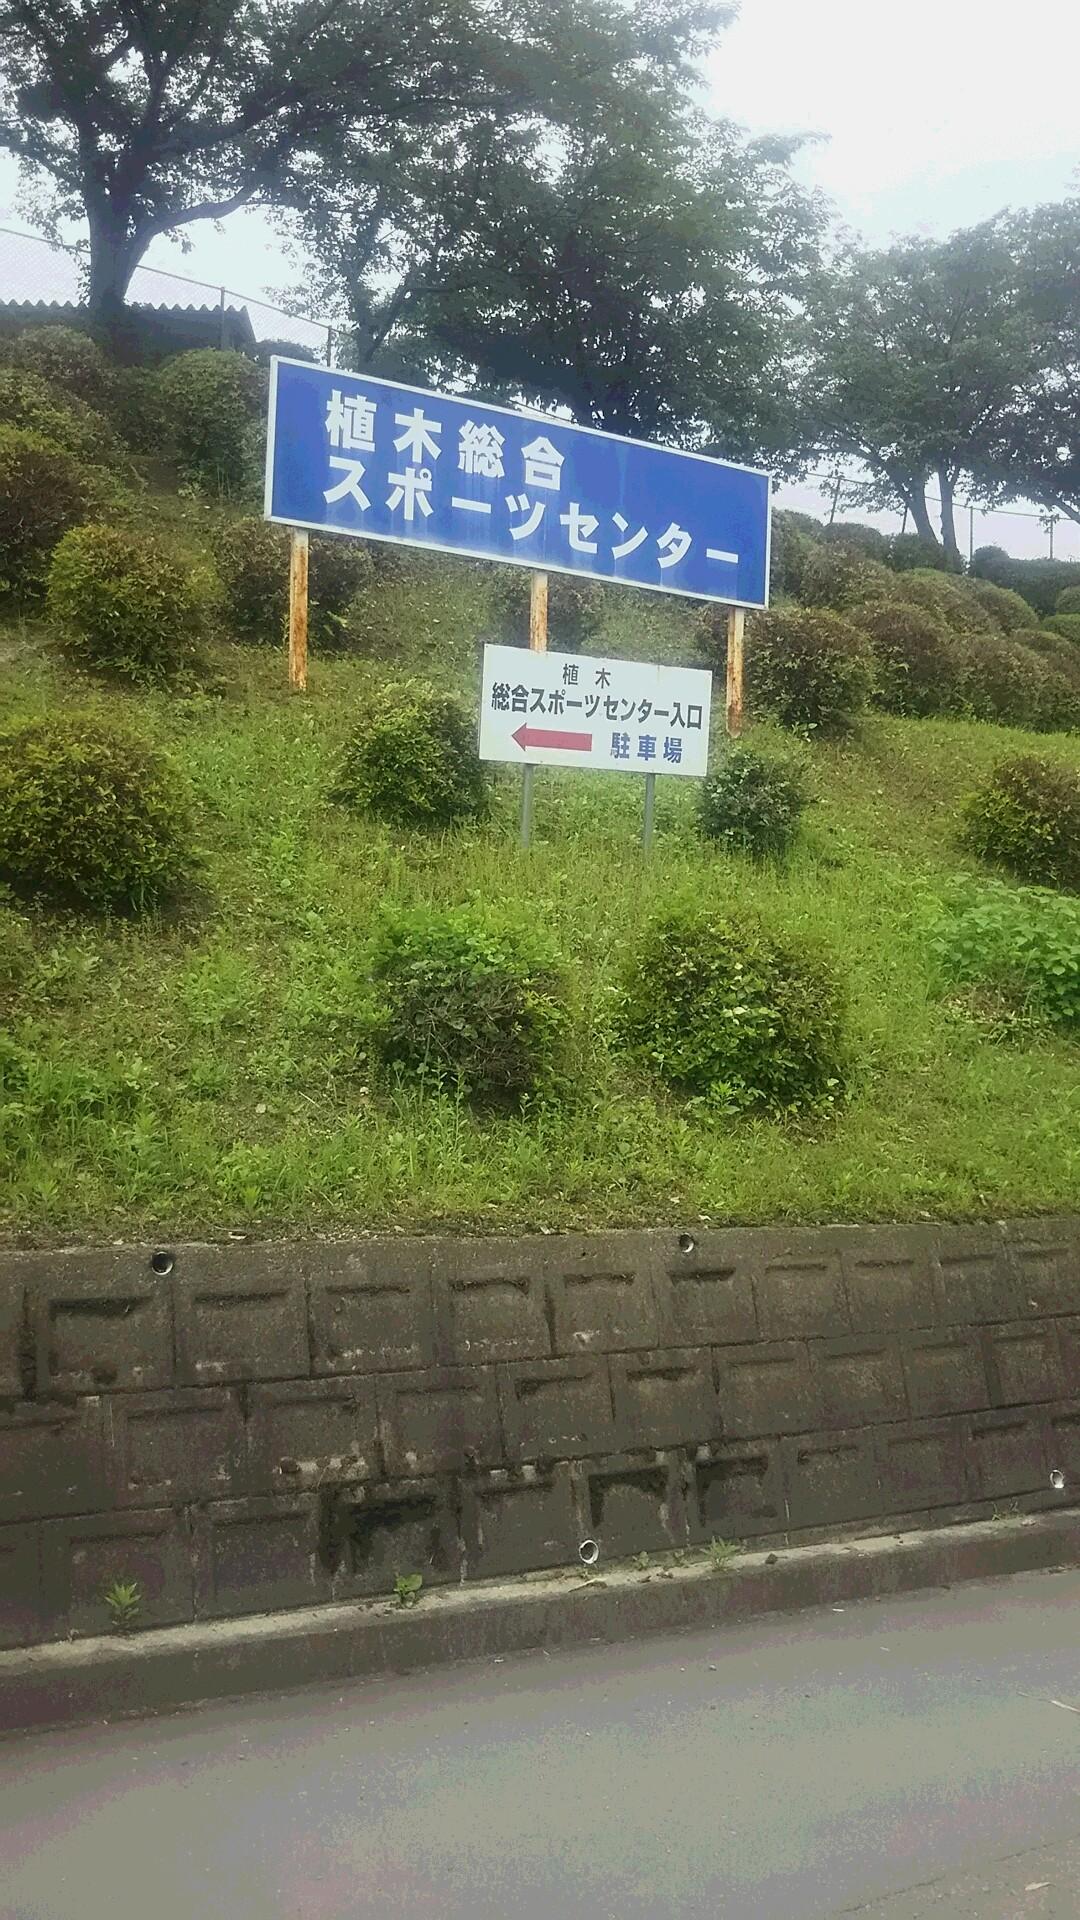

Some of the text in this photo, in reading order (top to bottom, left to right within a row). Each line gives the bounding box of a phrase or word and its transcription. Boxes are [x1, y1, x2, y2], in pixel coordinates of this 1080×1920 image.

[325, 389, 566, 492] 植木総合
[323, 455, 740, 570] スポーツセンター
[562, 664, 612, 689] 植木
[491, 682, 703, 730] 総合スポーツセンター入口
[610, 732, 683, 764] 駐車場
